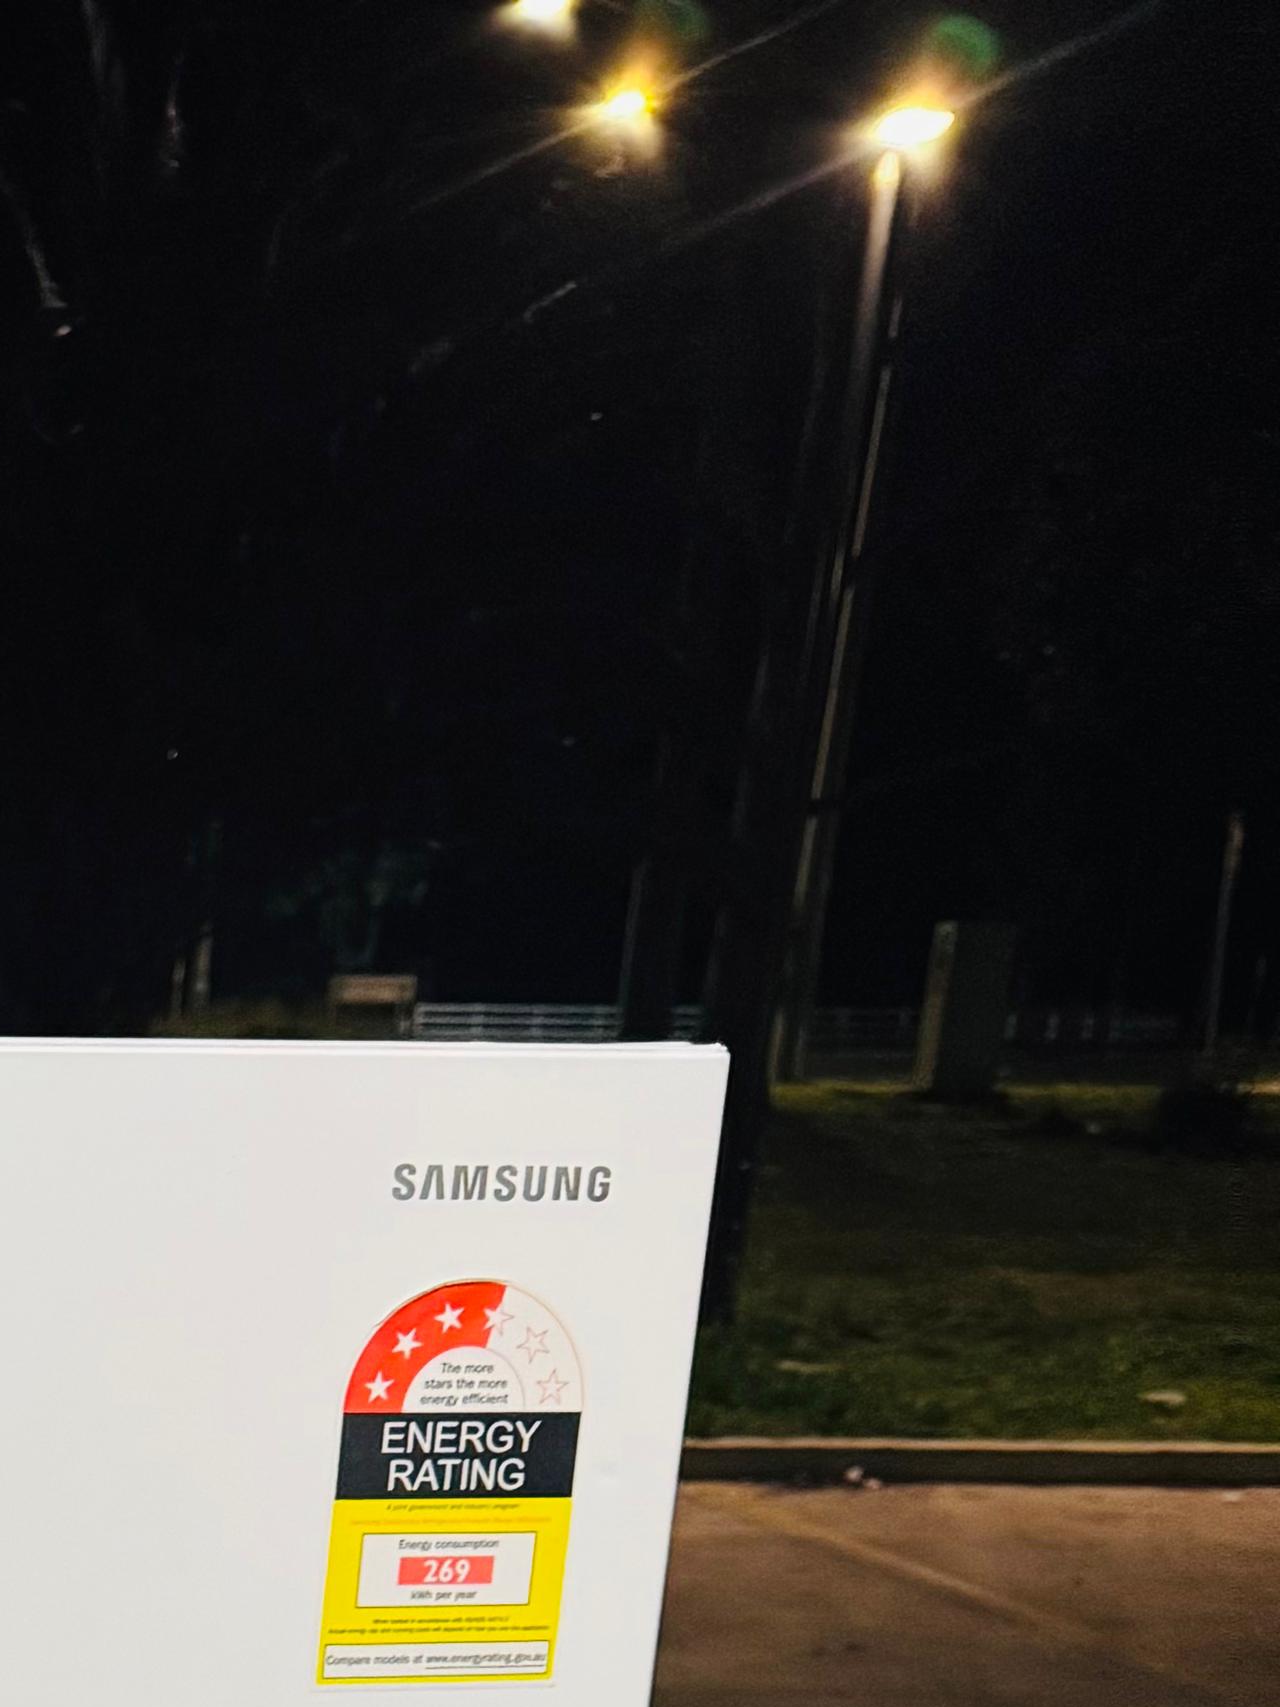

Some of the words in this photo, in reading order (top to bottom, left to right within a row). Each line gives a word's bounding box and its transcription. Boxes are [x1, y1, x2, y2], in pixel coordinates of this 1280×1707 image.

[391, 1162, 612, 1202] SAMSUNG
[440, 1362, 462, 1374] The
[464, 1363, 494, 1374] more
[424, 1379, 453, 1389] stars
[456, 1378, 475, 1389] the
[477, 1380, 508, 1389] more
[420, 1394, 459, 1407] energy
[381, 1420, 542, 1454] ENERGY
[387, 1458, 526, 1491] RATING
[398, 1539, 432, 1551] Energy
[434, 1538, 500, 1550] consumption
[423, 1558, 471, 1584] 269
